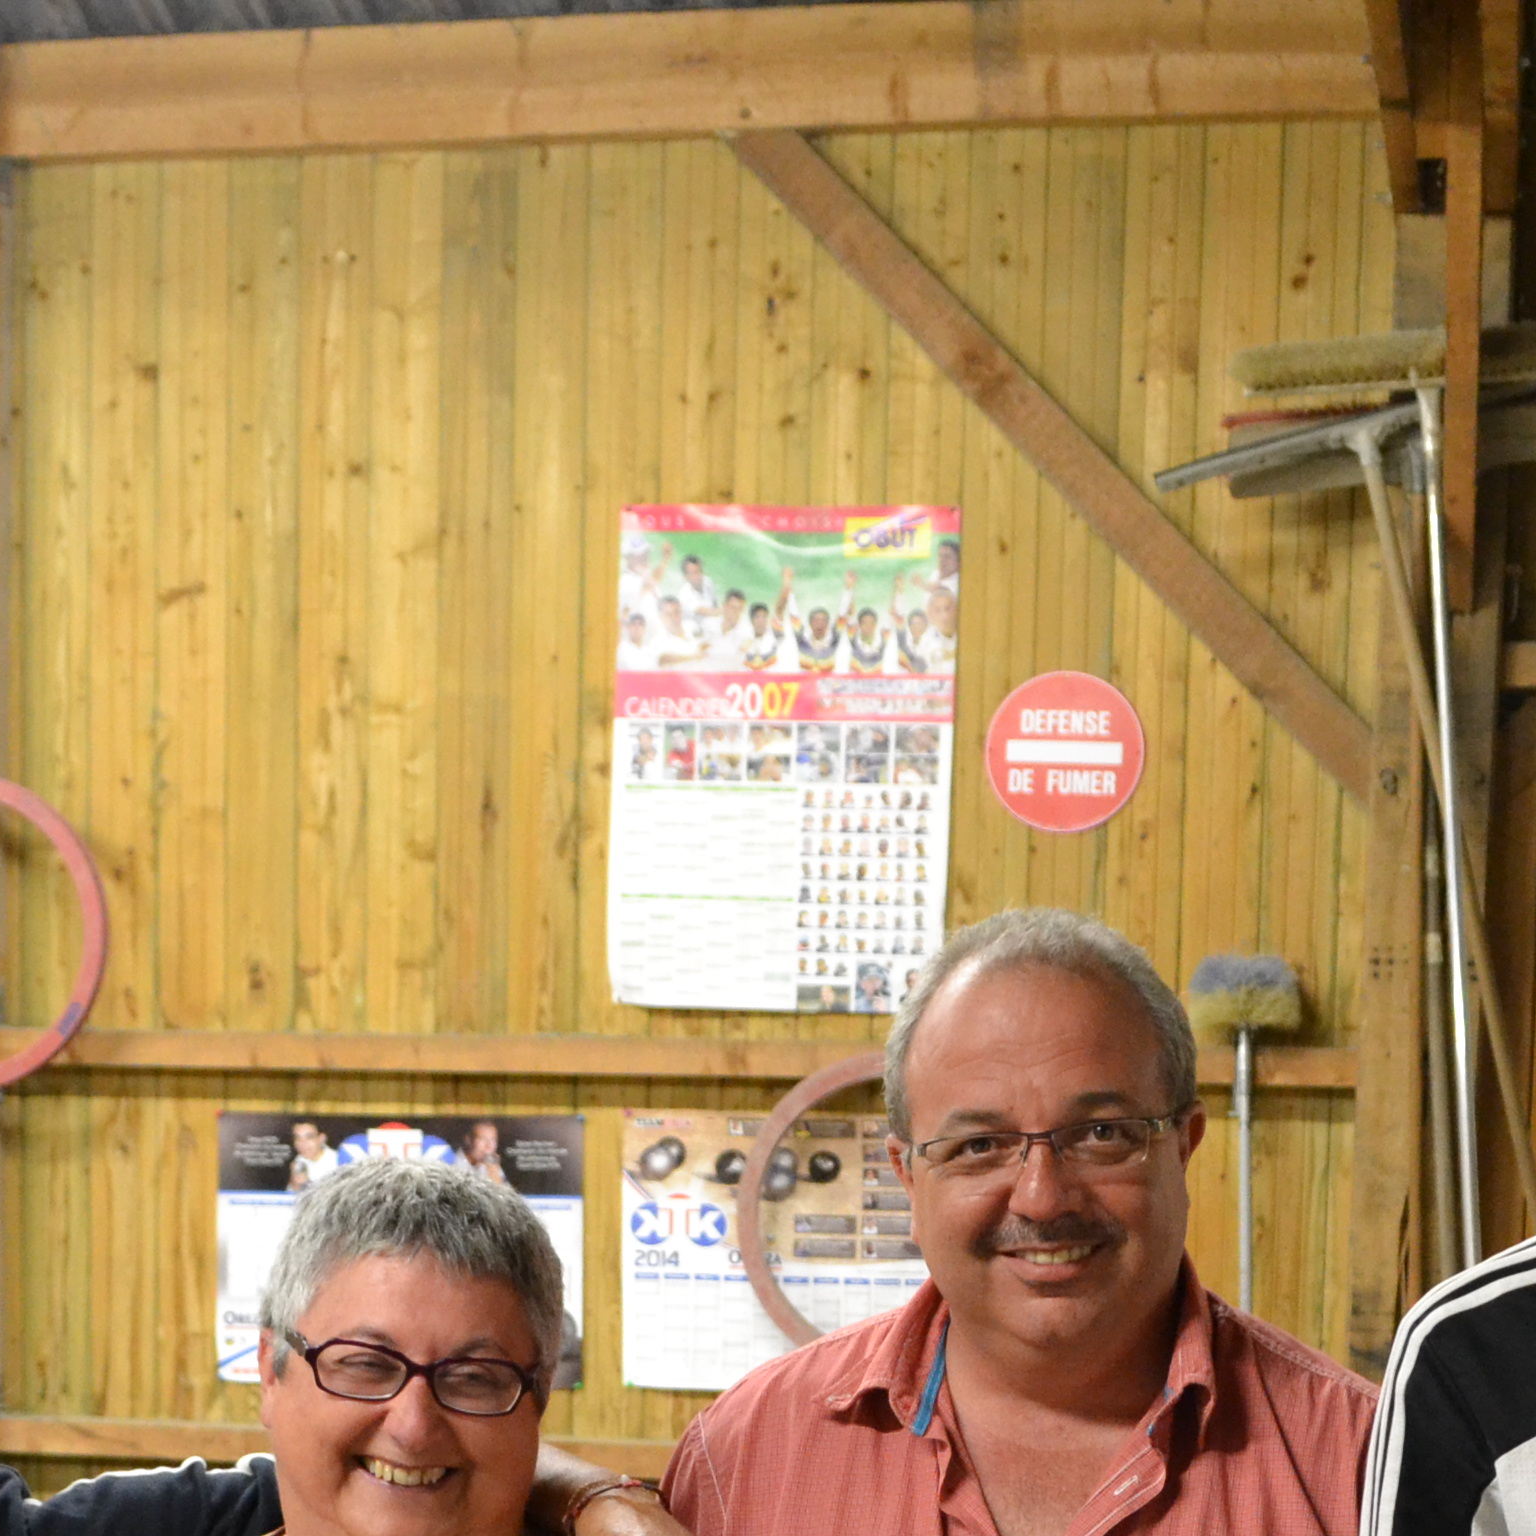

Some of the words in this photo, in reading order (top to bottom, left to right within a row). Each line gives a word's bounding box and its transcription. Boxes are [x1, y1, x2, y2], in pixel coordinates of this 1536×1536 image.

[724, 682, 800, 719] 2007
[1020, 708, 1111, 736] DEFENSE
[1007, 768, 1034, 794] DE
[1046, 768, 1116, 795] FUMER
[635, 1250, 680, 1267] 2014
